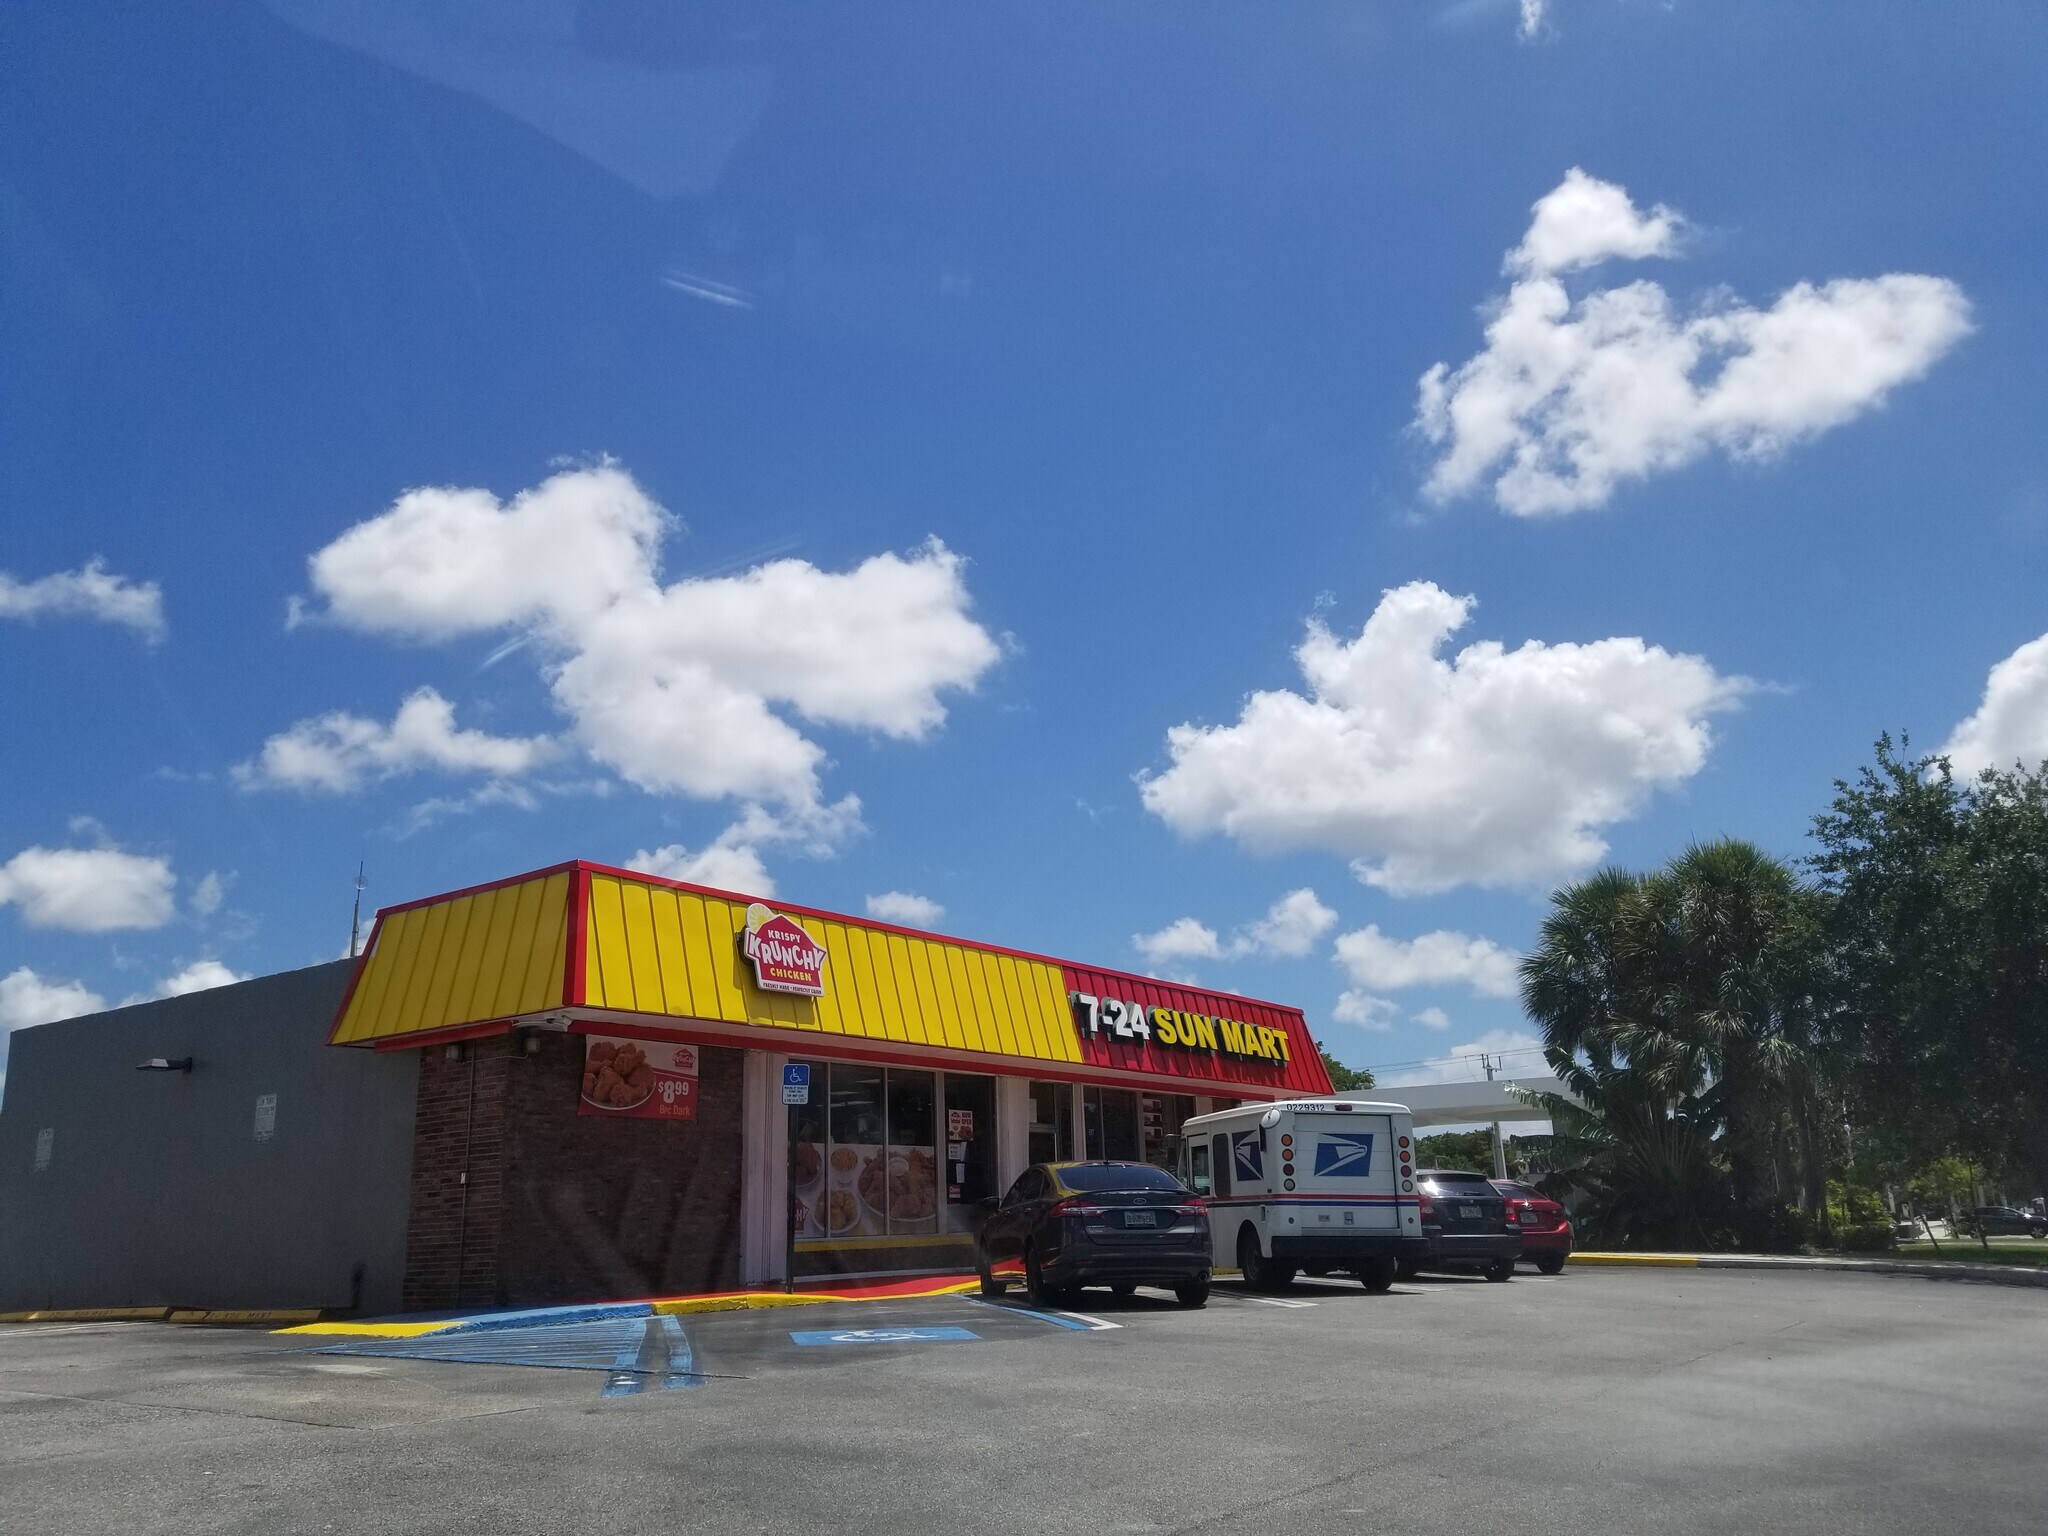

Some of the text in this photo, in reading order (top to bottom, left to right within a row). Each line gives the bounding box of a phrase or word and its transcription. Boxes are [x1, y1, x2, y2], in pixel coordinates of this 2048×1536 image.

[768, 929, 801, 943] KRISPY
[749, 934, 824, 971] KRUNCHY
[770, 967, 812, 982] CHICKEN
[1079, 993, 1290, 1062] 7-24 SUN MART
[673, 1105, 691, 1116] Dark
[1286, 1103, 1325, 1111] 0229312
